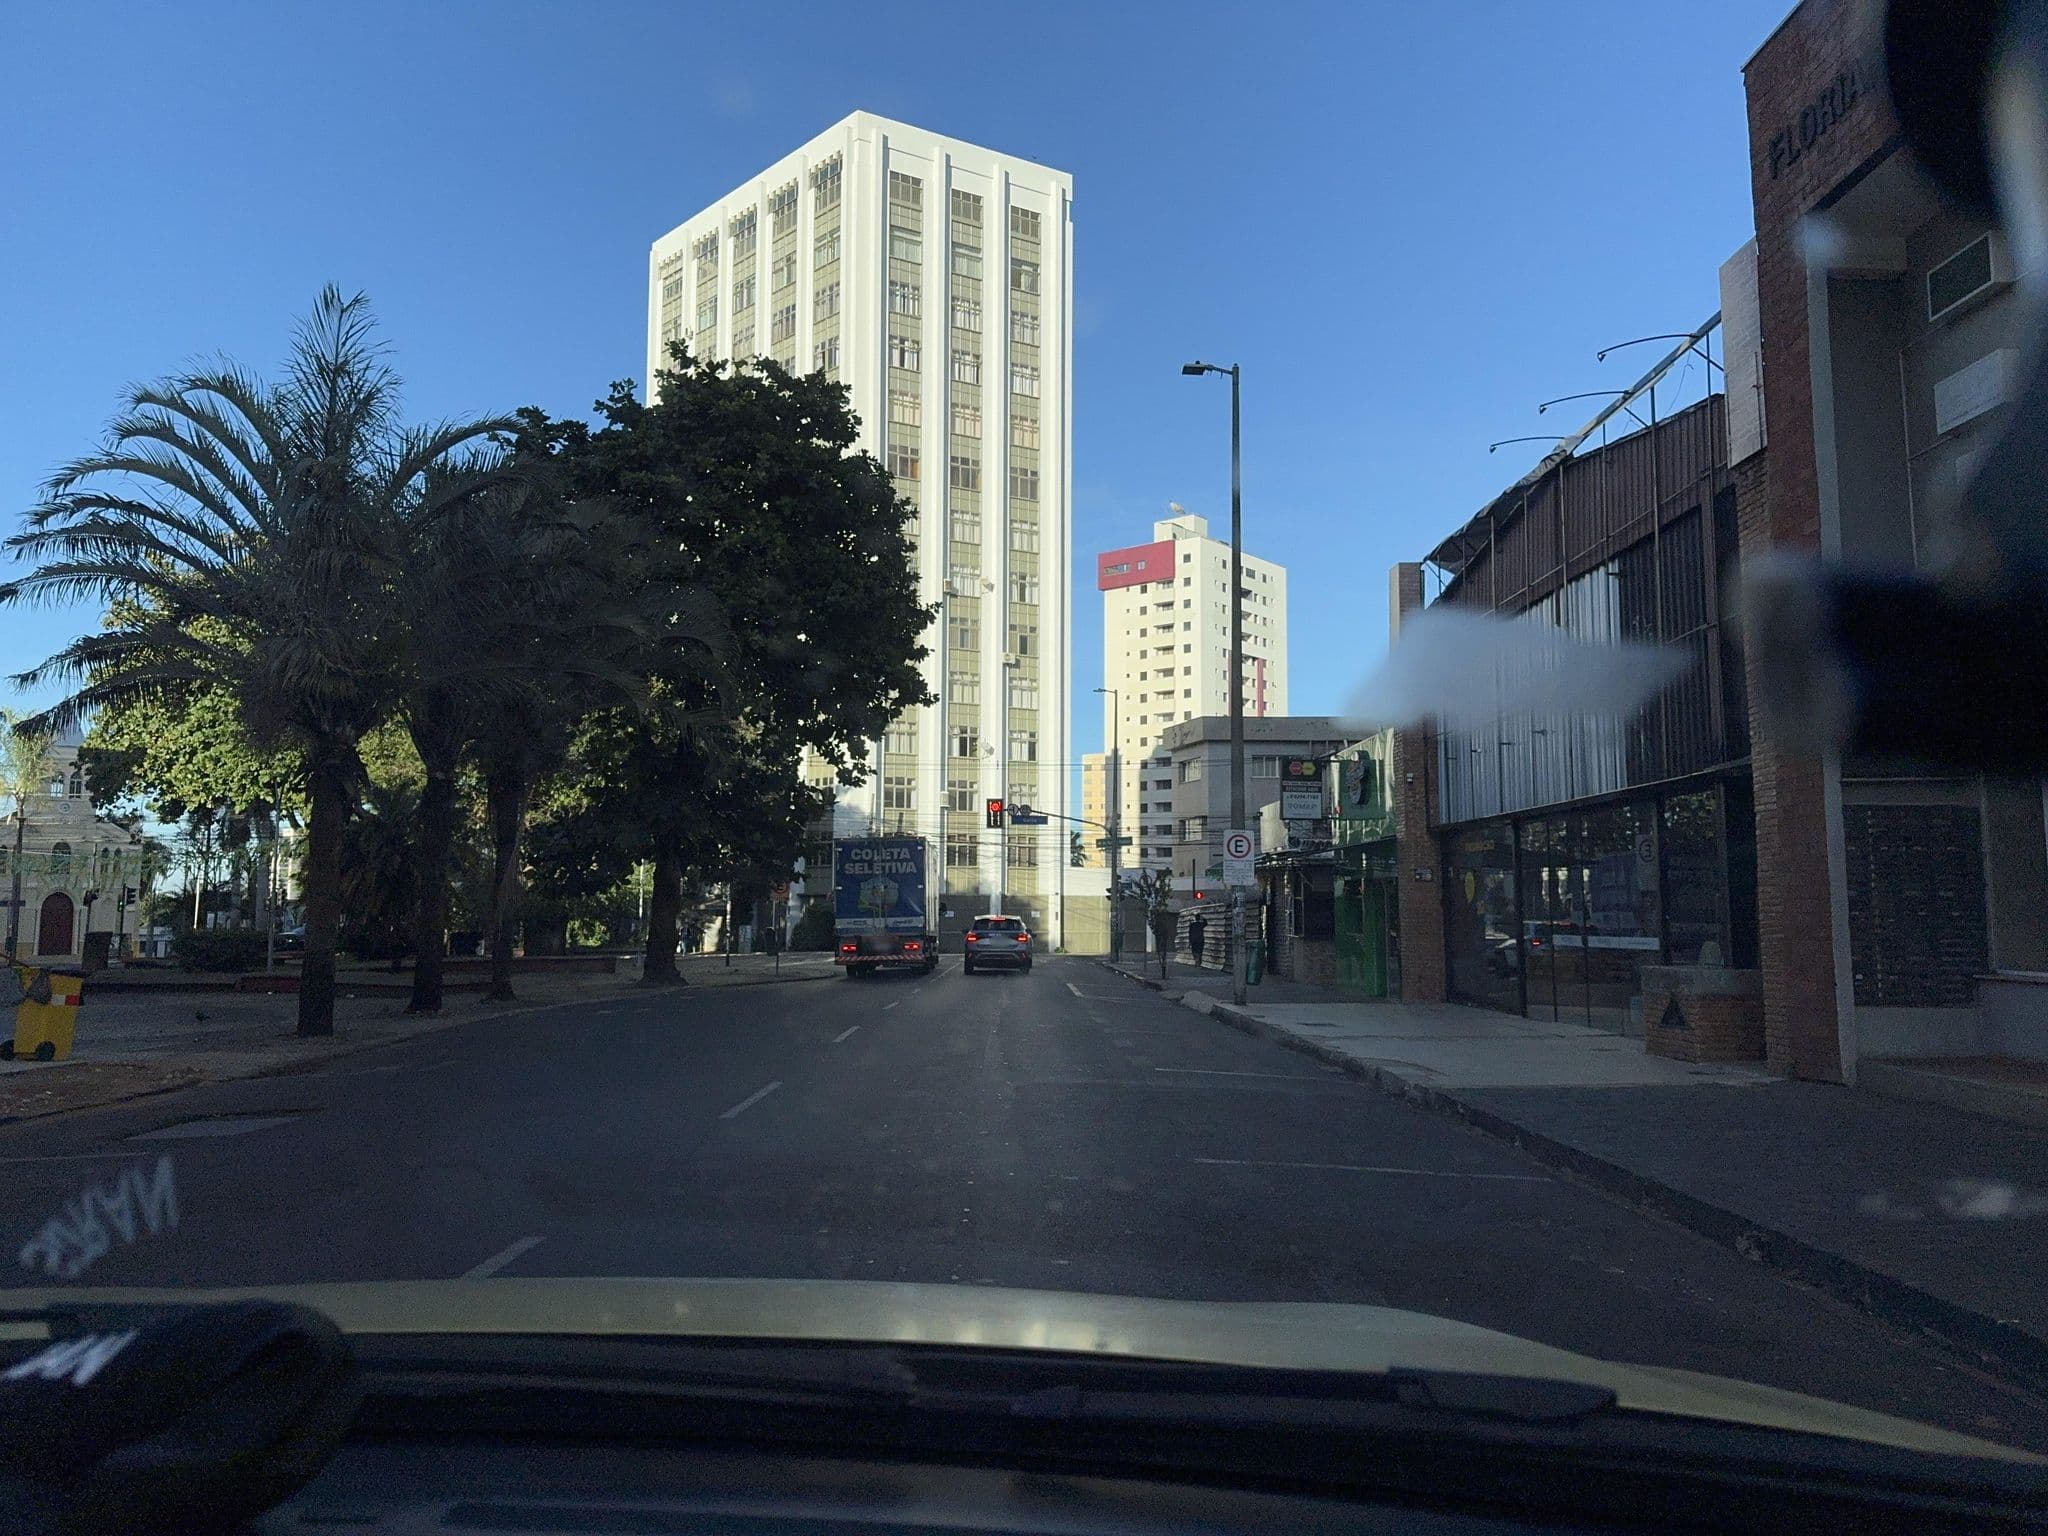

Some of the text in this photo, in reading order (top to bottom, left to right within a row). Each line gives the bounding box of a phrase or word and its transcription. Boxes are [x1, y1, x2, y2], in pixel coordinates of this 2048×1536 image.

[1235, 839, 1244, 854] E
[850, 848, 911, 861] COLETA
[844, 862, 917, 875] SELETIVA
